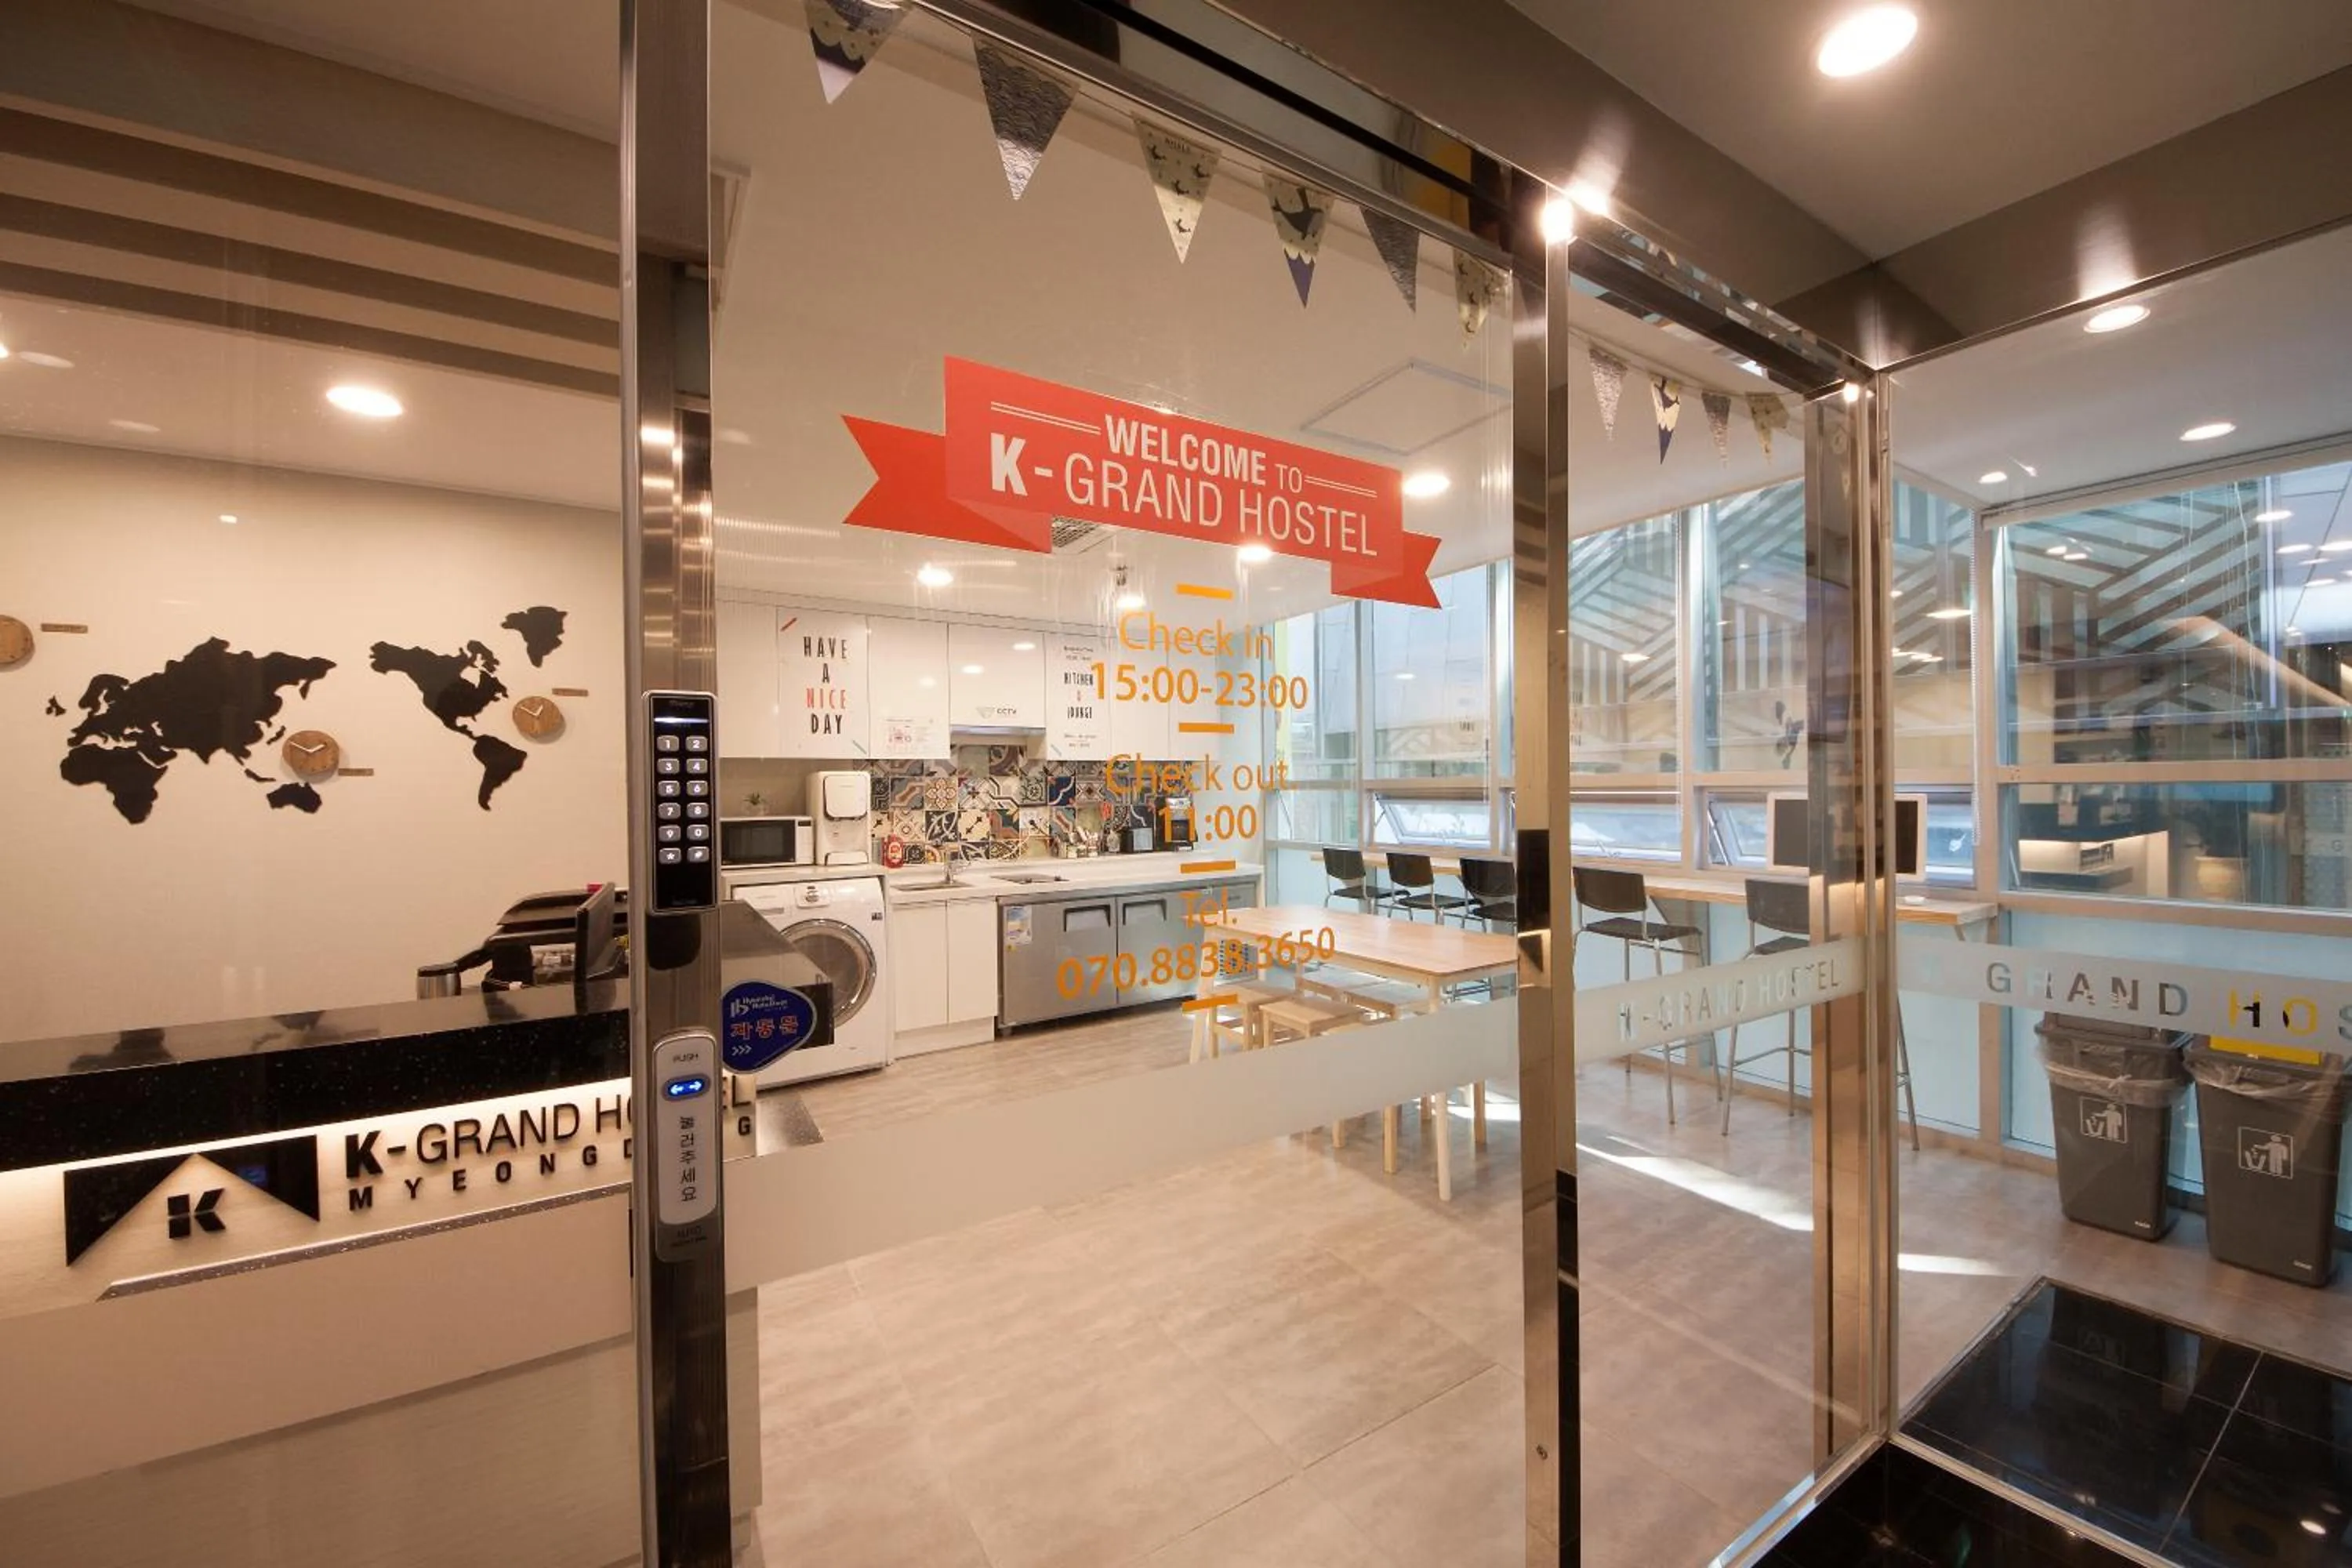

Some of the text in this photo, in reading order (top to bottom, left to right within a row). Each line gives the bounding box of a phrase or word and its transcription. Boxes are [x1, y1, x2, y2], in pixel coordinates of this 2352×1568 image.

[1105, 414, 1302, 493] WELCOME TO
[1239, 492, 1377, 557] HOSTEL
[803, 636, 847, 659] HAVE
[1119, 612, 1233, 657] Check
[822, 662, 830, 684] A
[1091, 662, 1308, 710] 15:00-23:00
[806, 688, 847, 710] NICE
[811, 713, 843, 735] DAY
[1105, 753, 1223, 795] Check
[1159, 804, 1258, 843] 11:00
[1180, 886, 1238, 929] Tel.
[1985, 962, 2191, 1017] GRAND
[345, 1102, 579, 1179] K-GRAND
[167, 1187, 226, 1240] K
